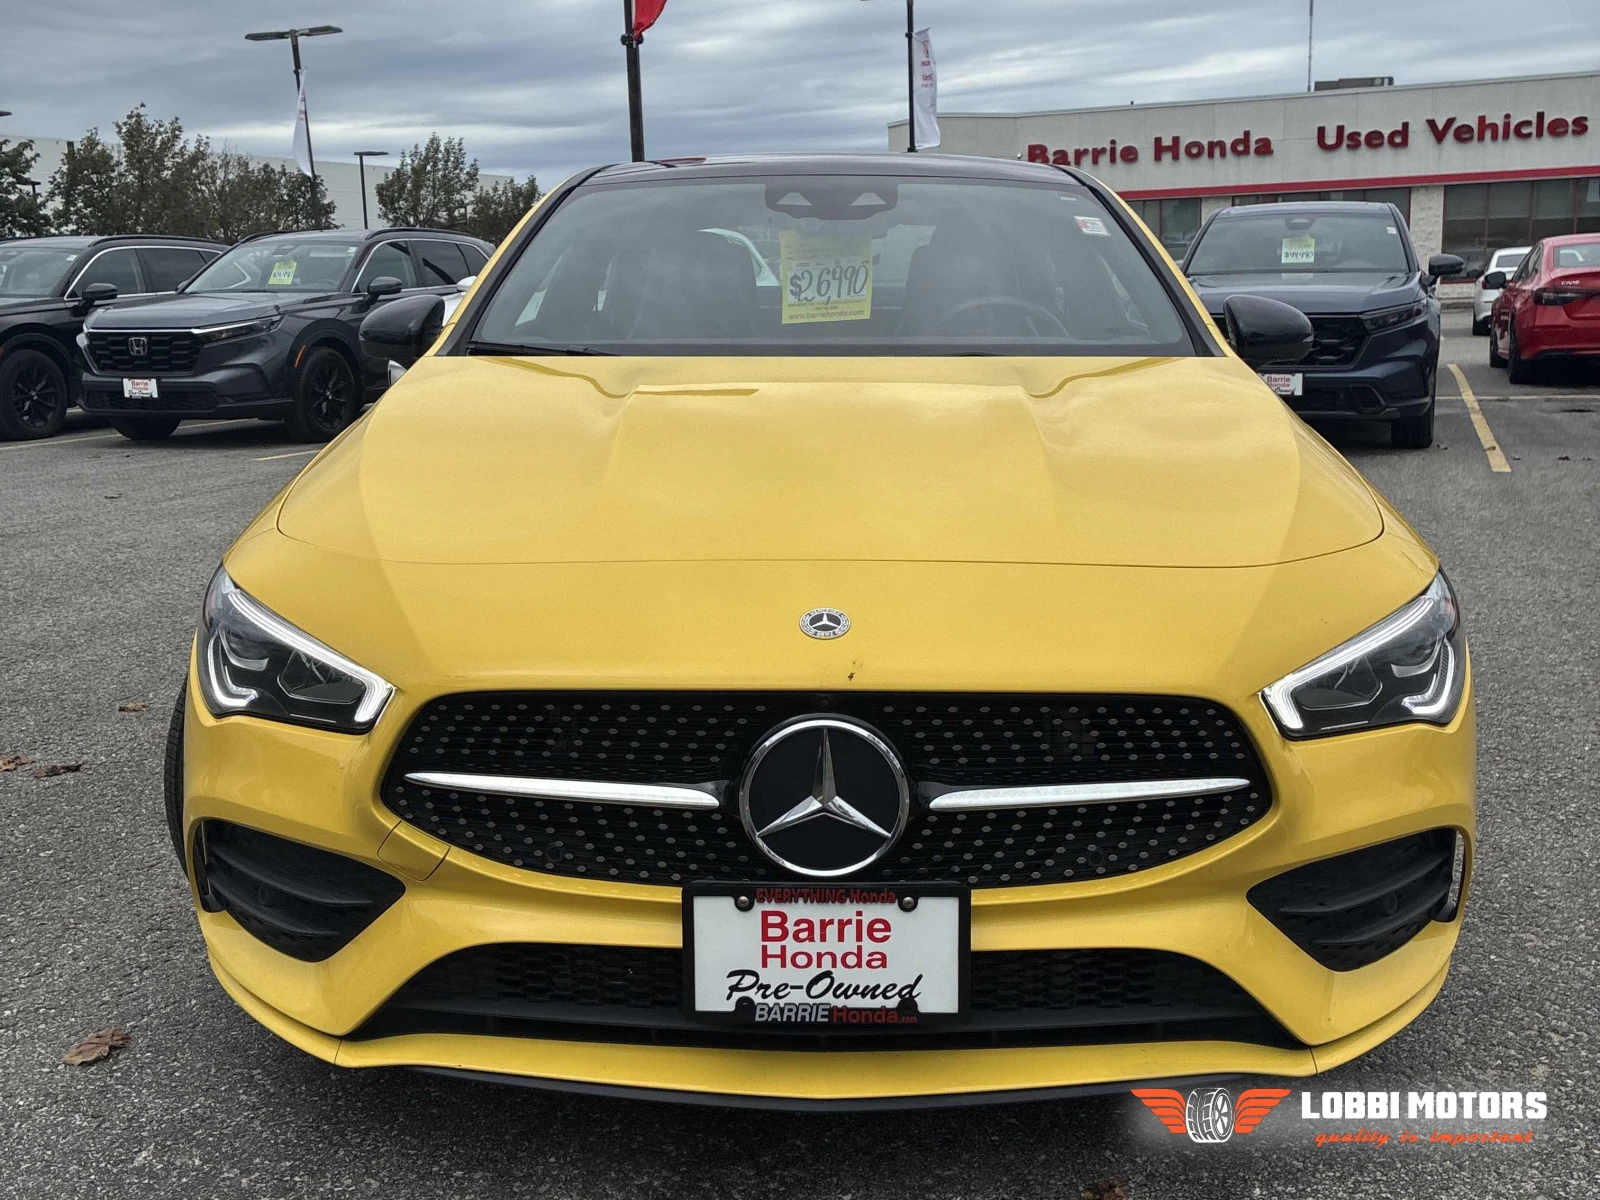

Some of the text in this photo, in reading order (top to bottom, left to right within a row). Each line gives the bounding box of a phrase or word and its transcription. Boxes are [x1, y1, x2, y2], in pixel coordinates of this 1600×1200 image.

[1028, 111, 1589, 166] Barrie Honda Used Vehicles
[788, 309, 865, 320] www.barriehonda.com
[755, 887, 897, 905] EVERYTHING Honda
[760, 910, 892, 944] Barrie
[761, 945, 888, 970] Honda
[725, 969, 924, 1002] Pre-Owned
[754, 1003, 831, 1023] BARRIE
